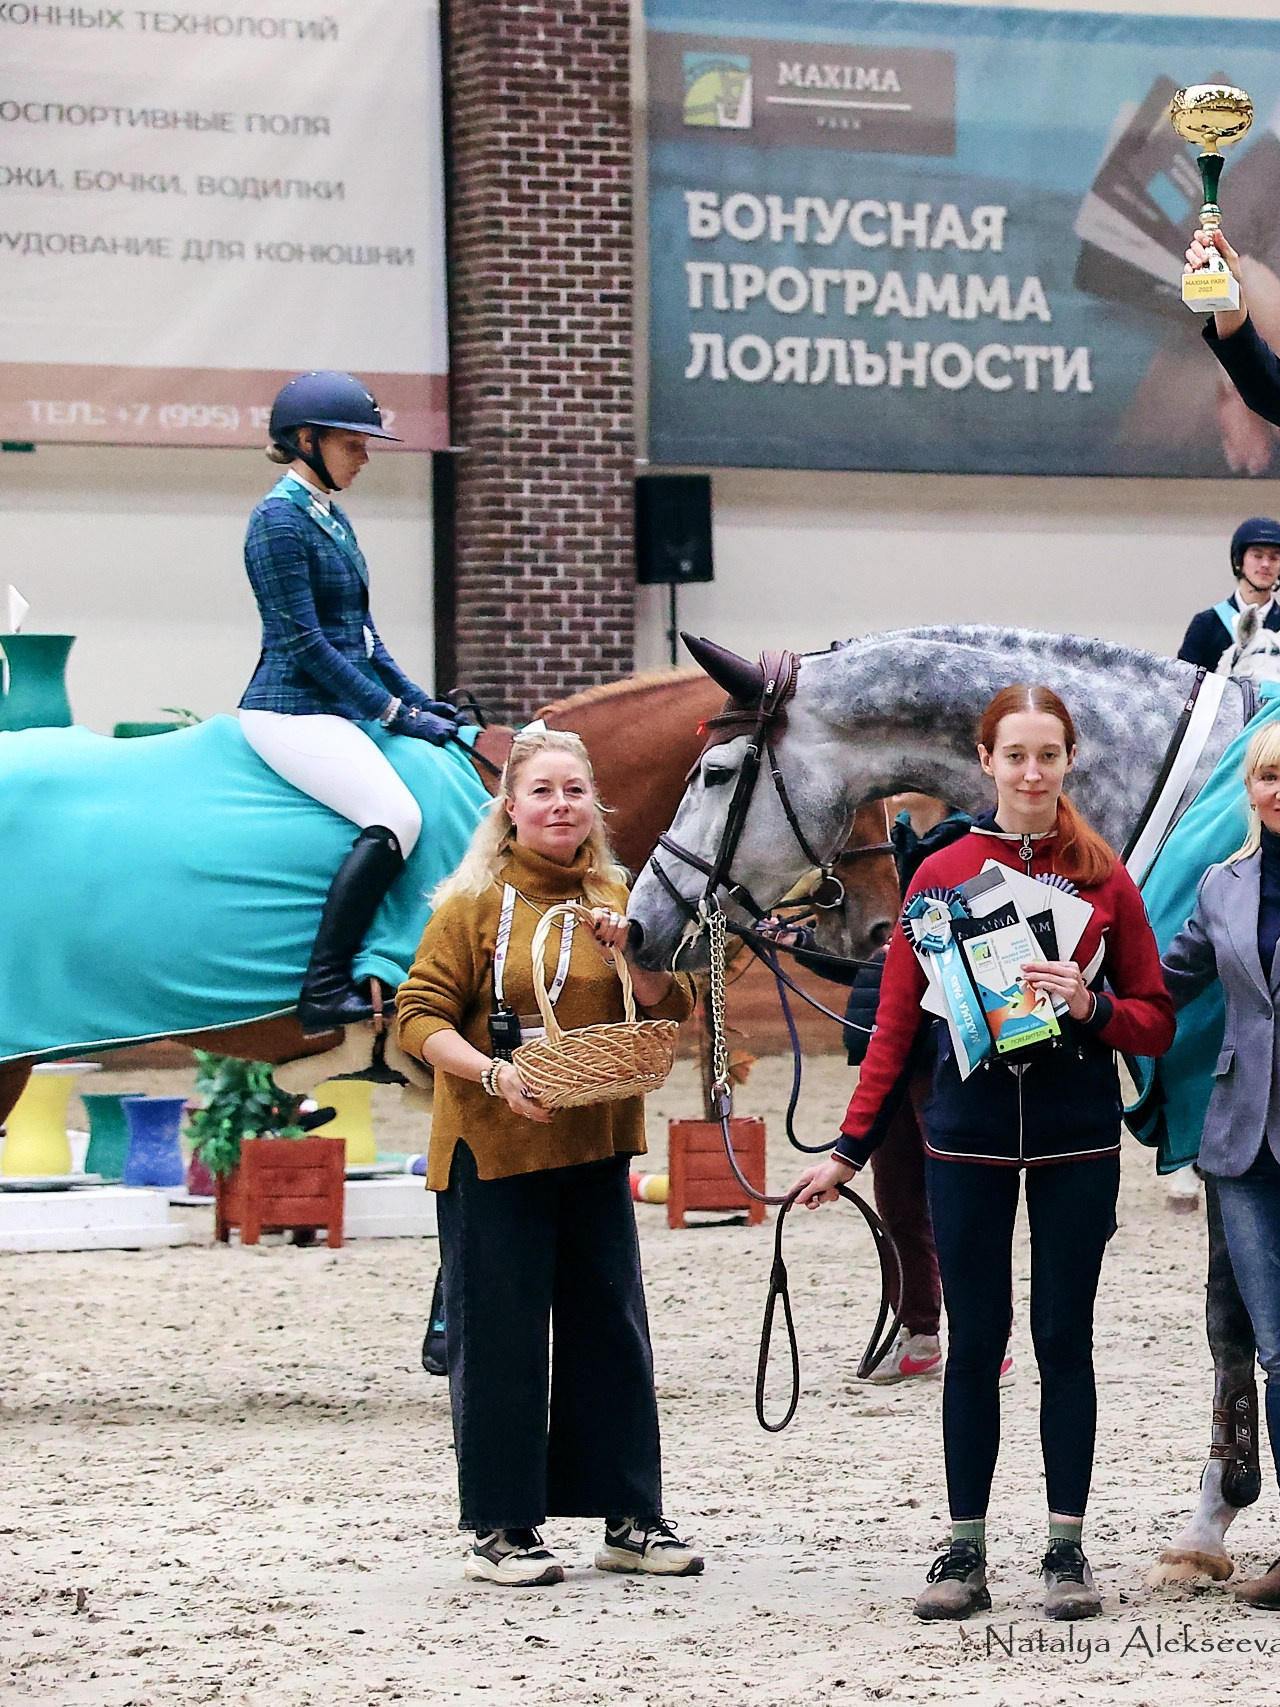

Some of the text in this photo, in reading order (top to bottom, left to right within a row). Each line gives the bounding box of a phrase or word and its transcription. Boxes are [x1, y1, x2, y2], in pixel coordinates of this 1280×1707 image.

[135, 10, 339, 41] ТЕХНОЛОГИЙ
[777, 61, 901, 92] MAXIMA
[245, 112, 331, 136] ПОЛЯ
[196, 175, 346, 201] ВОДИЛКИ
[685, 190, 1007, 252] БОНУСНАЯ
[0, 232, 416, 266] УДОВАНИЕ ДЛЯ КОНЮШНИ
[685, 262, 1051, 322] ПРОГРАММА
[685, 333, 1093, 393] ЛОЯЛЬНОСТИ
[115, 403, 151, 426] +7
[958, 1000, 981, 1044] MAXIMA
